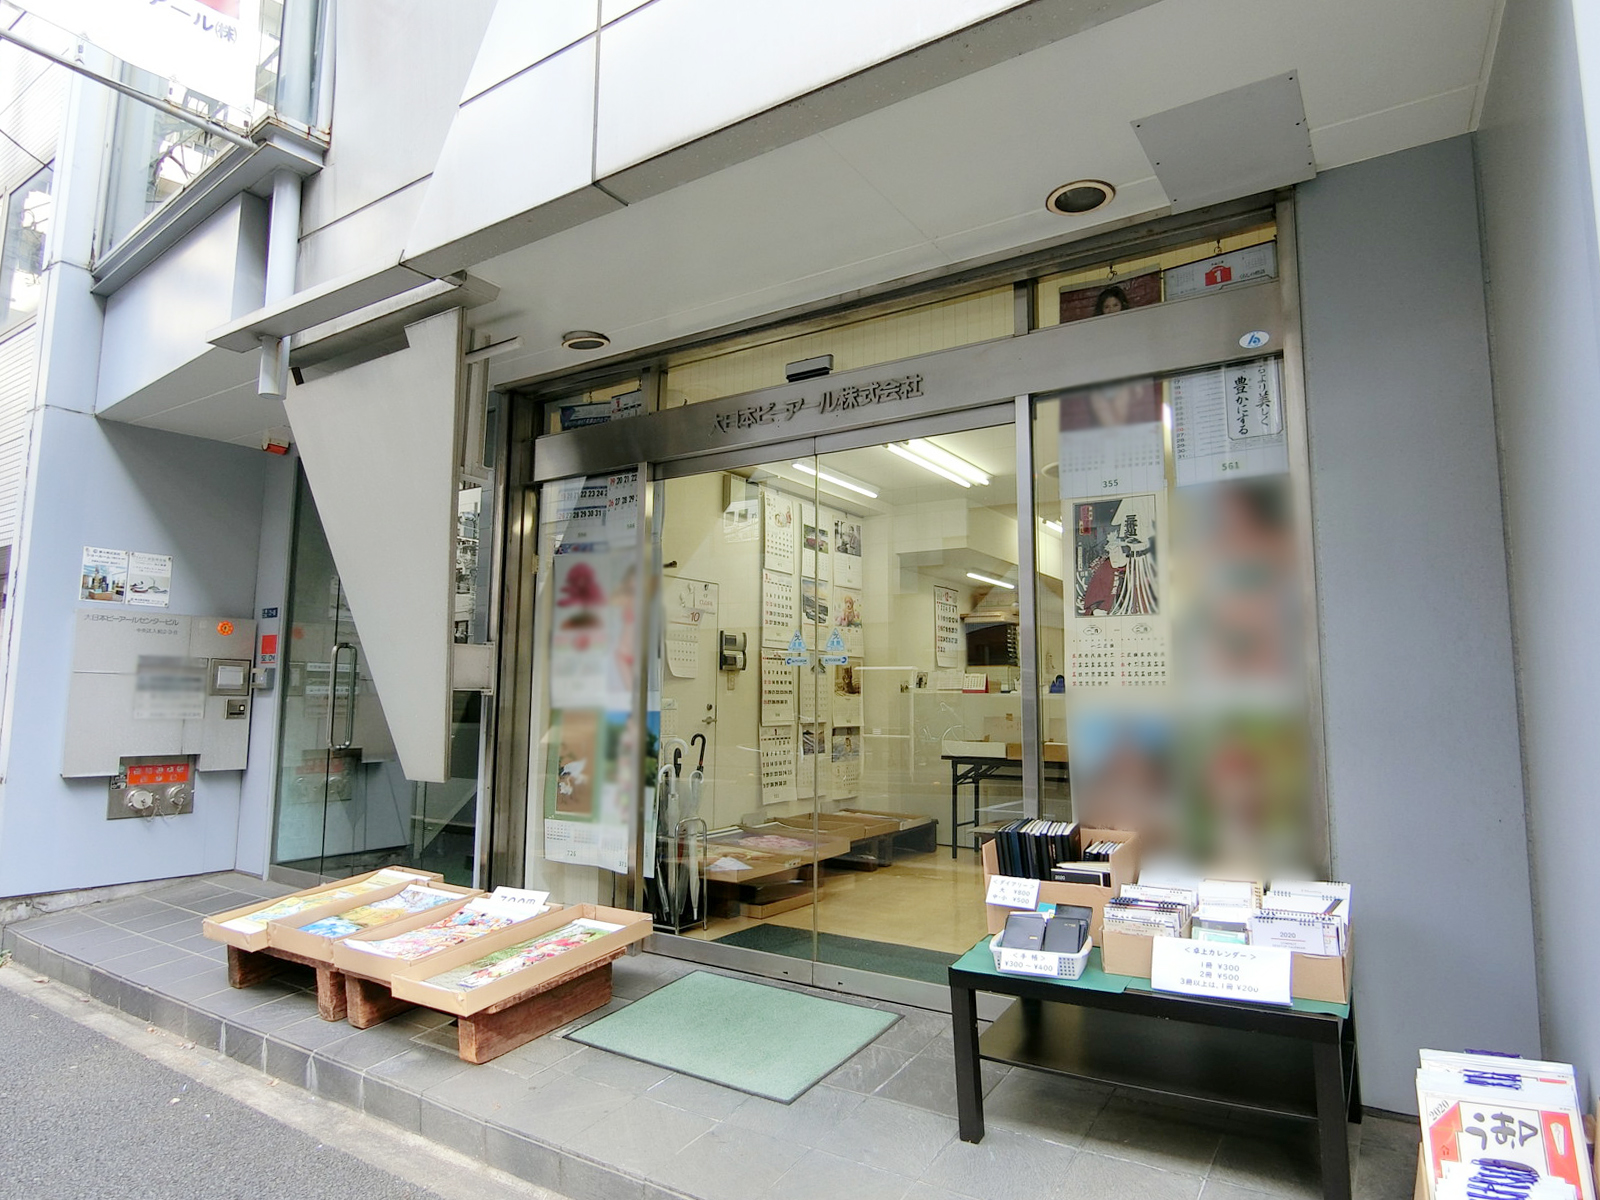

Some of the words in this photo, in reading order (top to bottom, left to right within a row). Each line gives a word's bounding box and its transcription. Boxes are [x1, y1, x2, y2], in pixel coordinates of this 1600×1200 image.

[1222, 461, 1240, 471] 561
[1102, 479, 1119, 488] 355
[1012, 896, 1030, 904] ¥500
[1280, 931, 1297, 939] 2020
[1217, 963, 1240, 972] ¥300
[1217, 972, 1240, 982] ¥500
[1429, 1100, 1450, 1121] 2020
